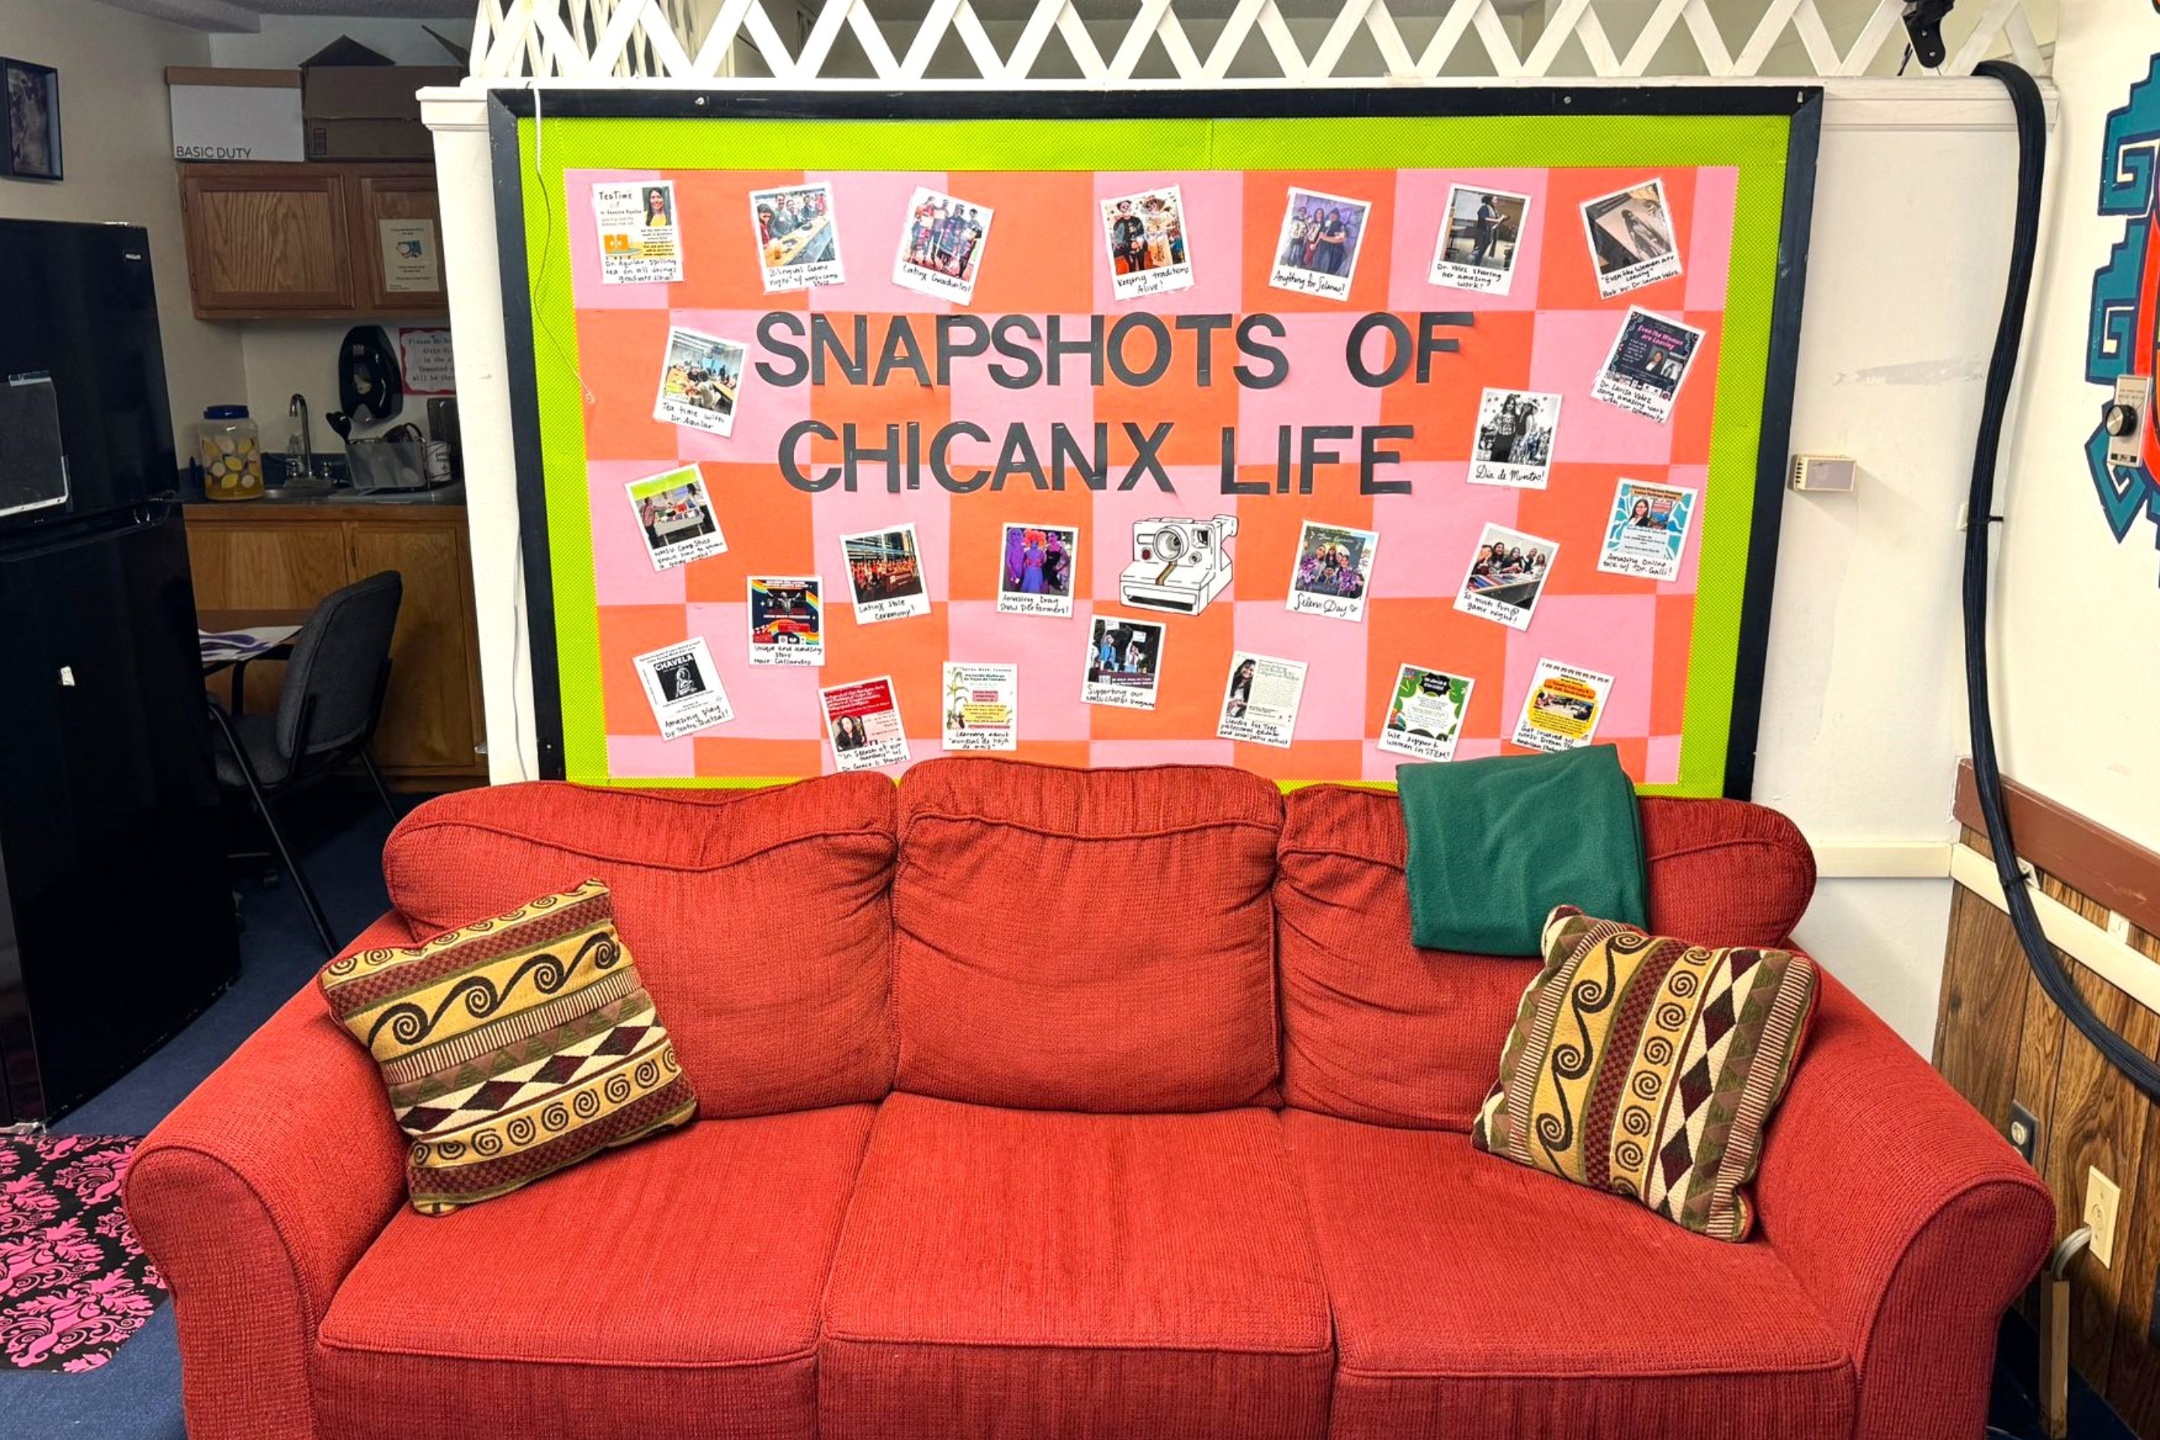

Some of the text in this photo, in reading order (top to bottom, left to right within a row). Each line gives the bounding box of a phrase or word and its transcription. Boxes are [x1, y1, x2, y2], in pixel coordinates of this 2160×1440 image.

[176, 146, 251, 158] BASIC DUTY
[755, 311, 1474, 390] SNAPSHOTS OF
[778, 420, 1414, 495] CHICANX LIFE
[1324, 599, 1348, 617] Day
[1467, 602, 1487, 614] game
[655, 654, 694, 672] CHAVELA
